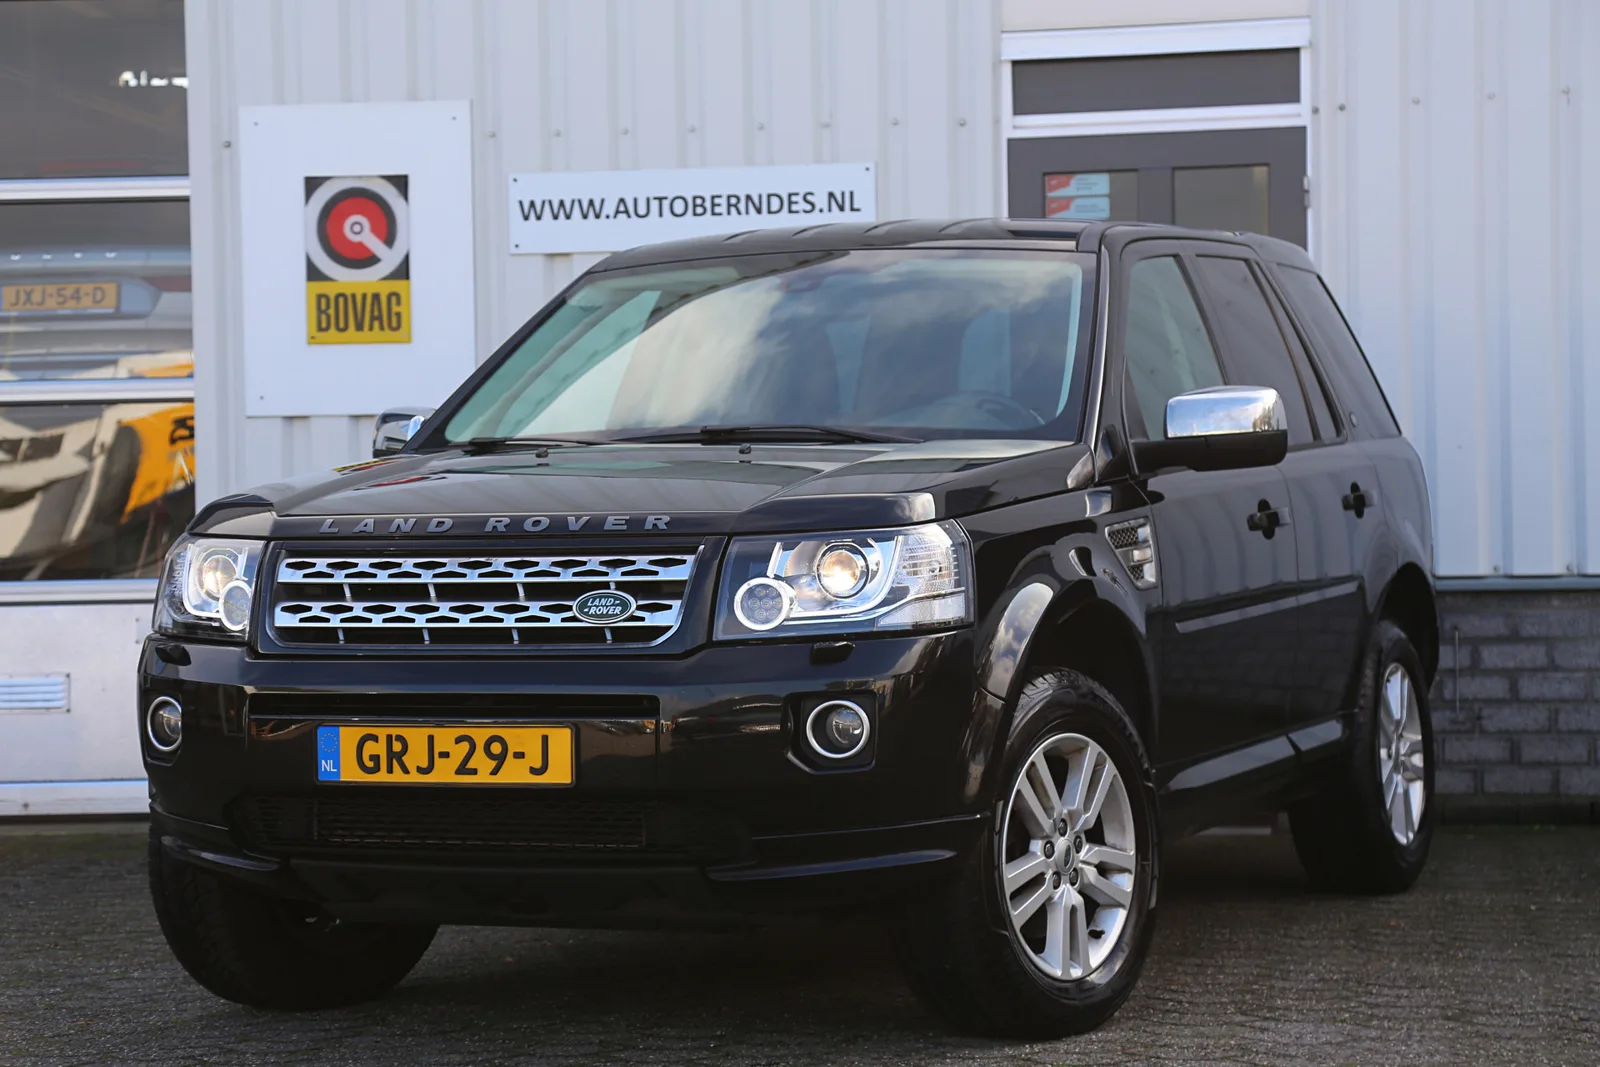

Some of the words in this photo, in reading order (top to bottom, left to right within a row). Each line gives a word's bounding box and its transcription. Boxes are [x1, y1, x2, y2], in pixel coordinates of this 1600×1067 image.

[518, 190, 861, 221] WWW.AUTOBERNDES.NL
[10, 286, 106, 307] JXJ-54-D
[316, 291, 402, 333] BOVAG
[319, 517, 453, 533] LAND
[484, 515, 671, 531] ROVER
[321, 759, 337, 772] NL
[355, 733, 549, 776] GRJ-29-J
